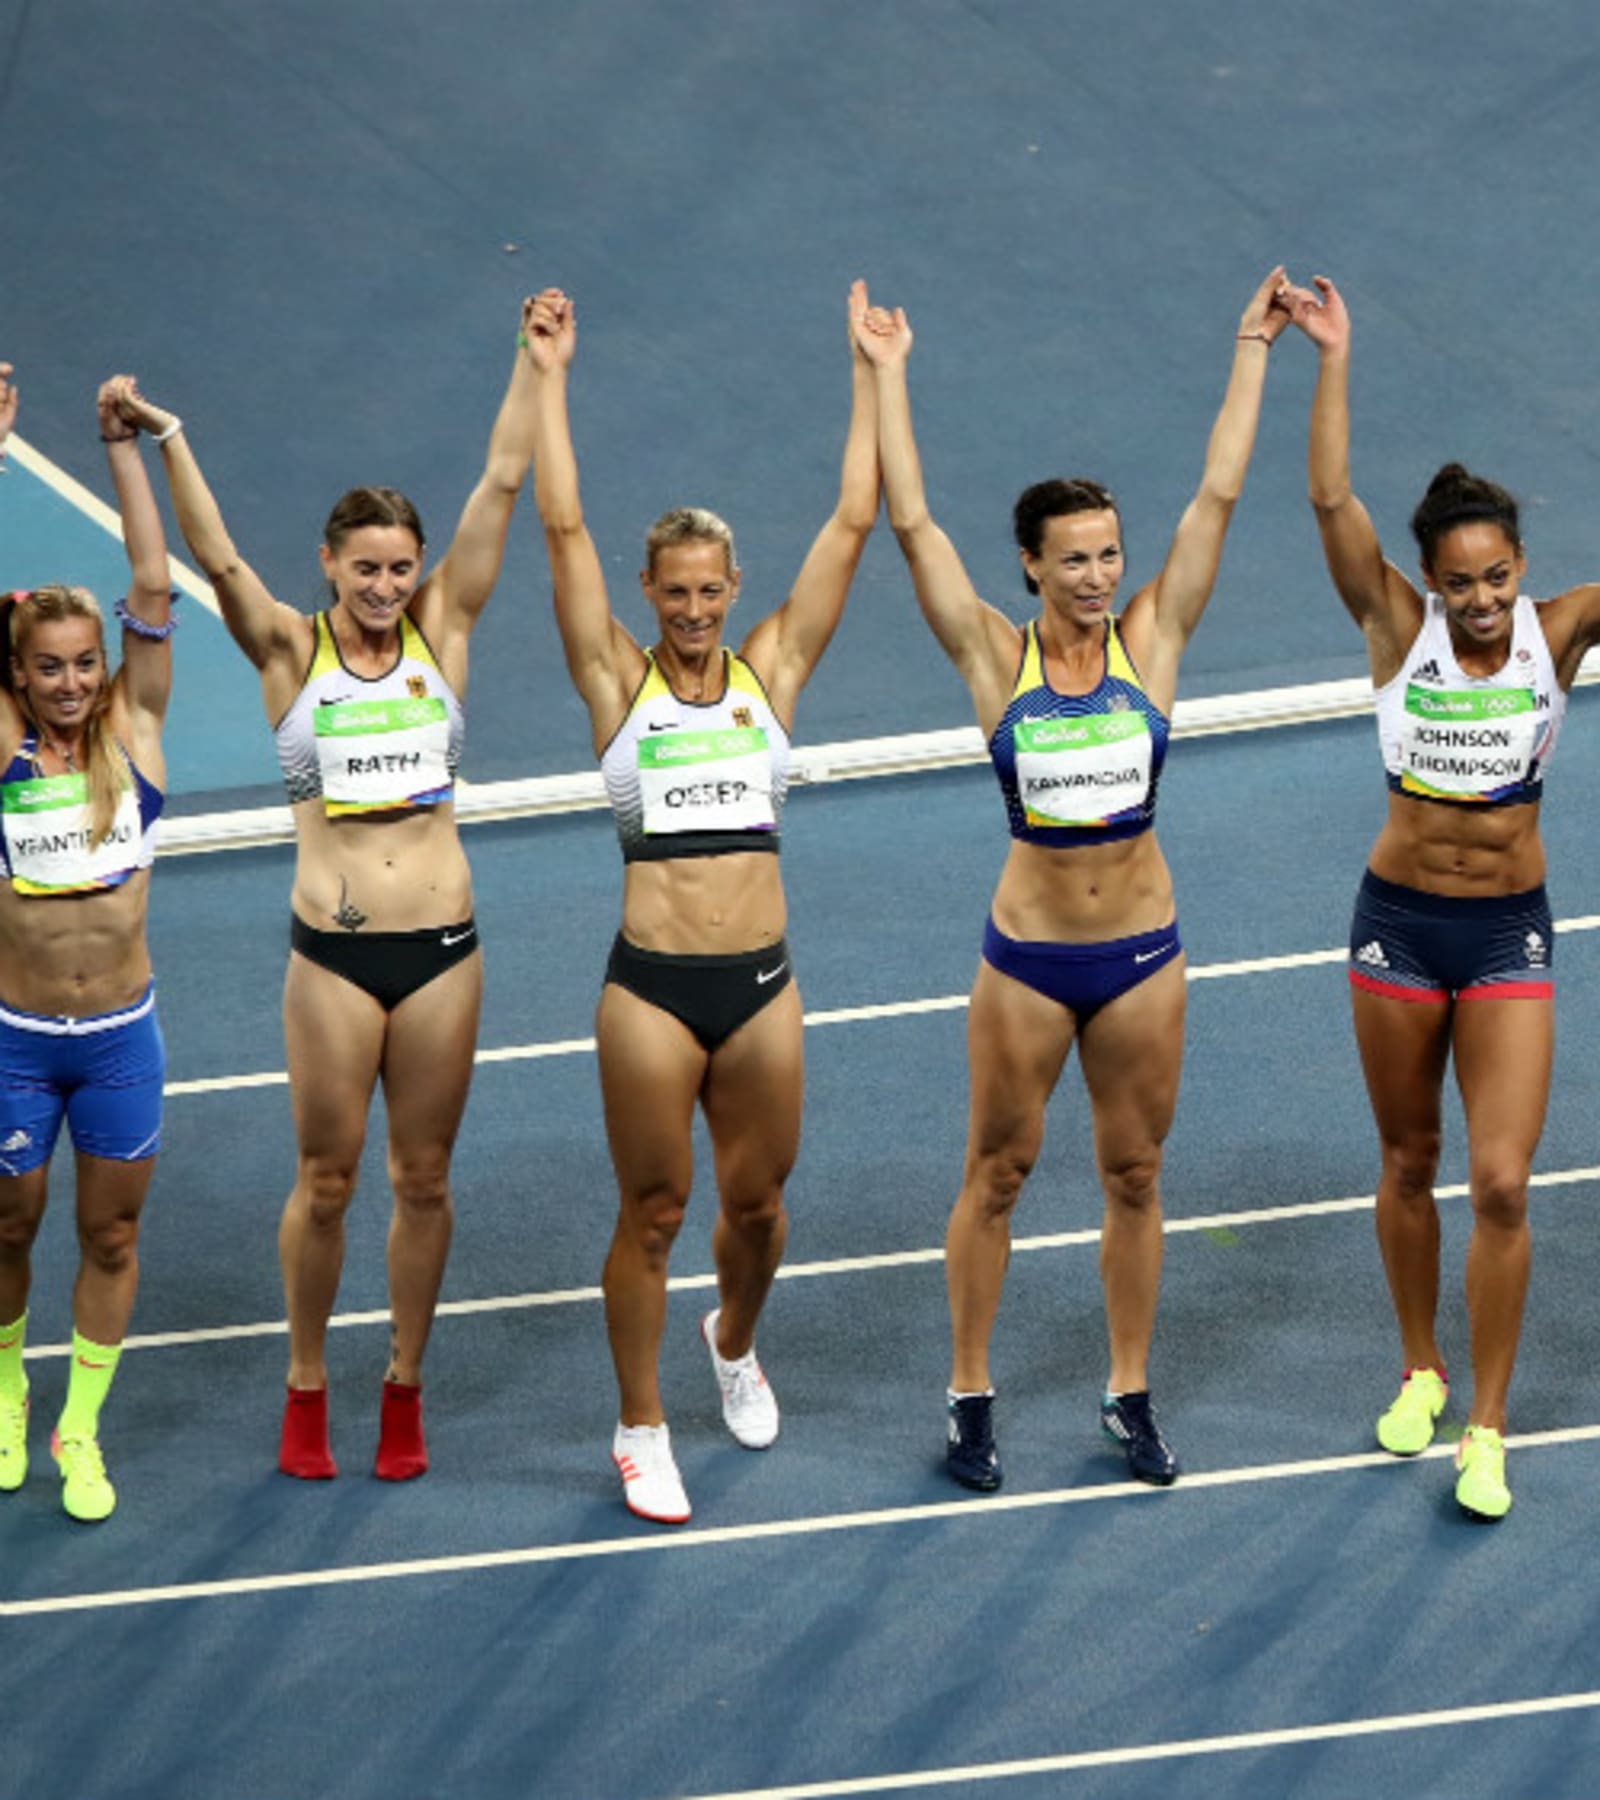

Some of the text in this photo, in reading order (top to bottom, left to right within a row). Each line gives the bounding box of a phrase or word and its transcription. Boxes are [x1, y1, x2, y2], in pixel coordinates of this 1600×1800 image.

[1414, 727, 1511, 747] JOHNSON
[347, 751, 421, 776] RATH
[1408, 752, 1521, 776] THOMPSON
